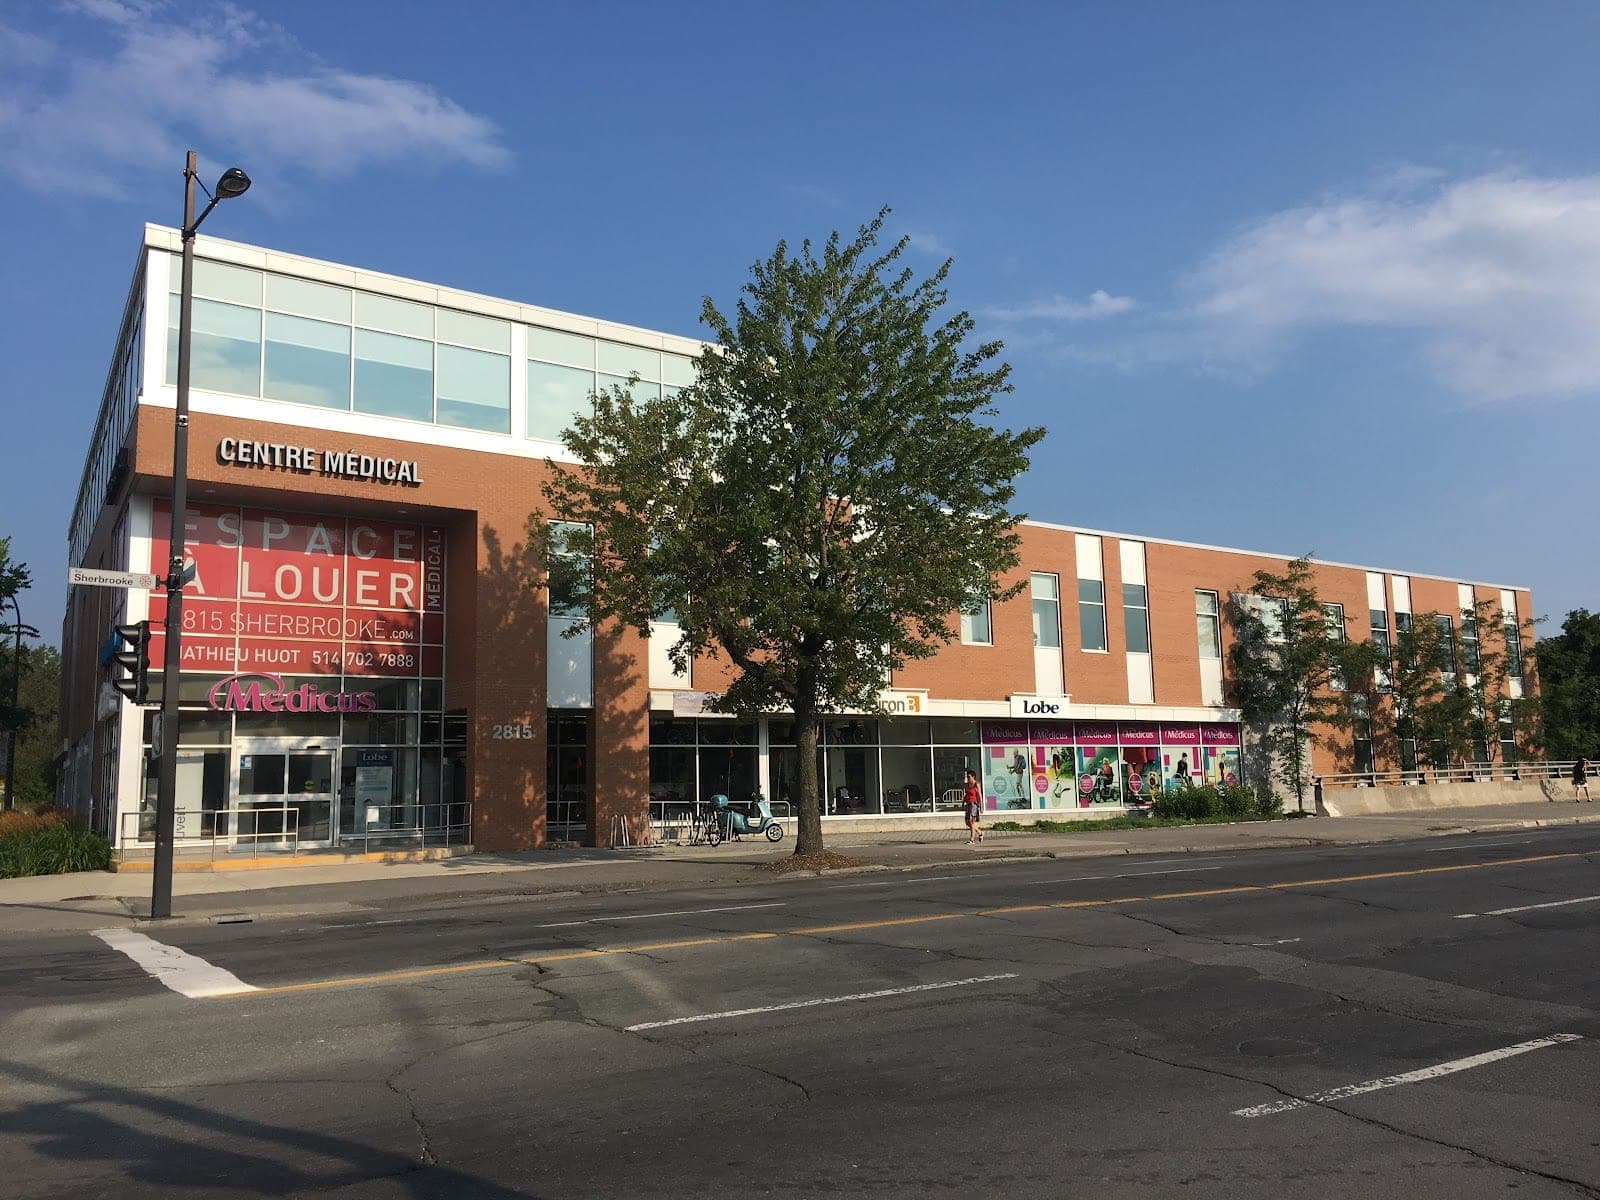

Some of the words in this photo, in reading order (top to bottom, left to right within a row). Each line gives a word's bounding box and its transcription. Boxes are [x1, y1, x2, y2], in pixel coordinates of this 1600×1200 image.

[220, 437, 315, 470] CENTRE
[324, 448, 424, 483] MÉDICAL
[74, 573, 134, 586] Sherbrooke
[241, 561, 415, 607] LOUER
[182, 609, 223, 632] 815
[180, 646, 249, 662] ATHIEU
[254, 649, 301, 664] HUOT
[312, 651, 340, 665] 514
[346, 652, 373, 667] 702
[379, 653, 414, 668] 7888
[877, 699, 905, 713] iron
[1023, 700, 1060, 714] Lobe
[492, 724, 534, 740] 2815
[362, 752, 389, 762] Lobe
